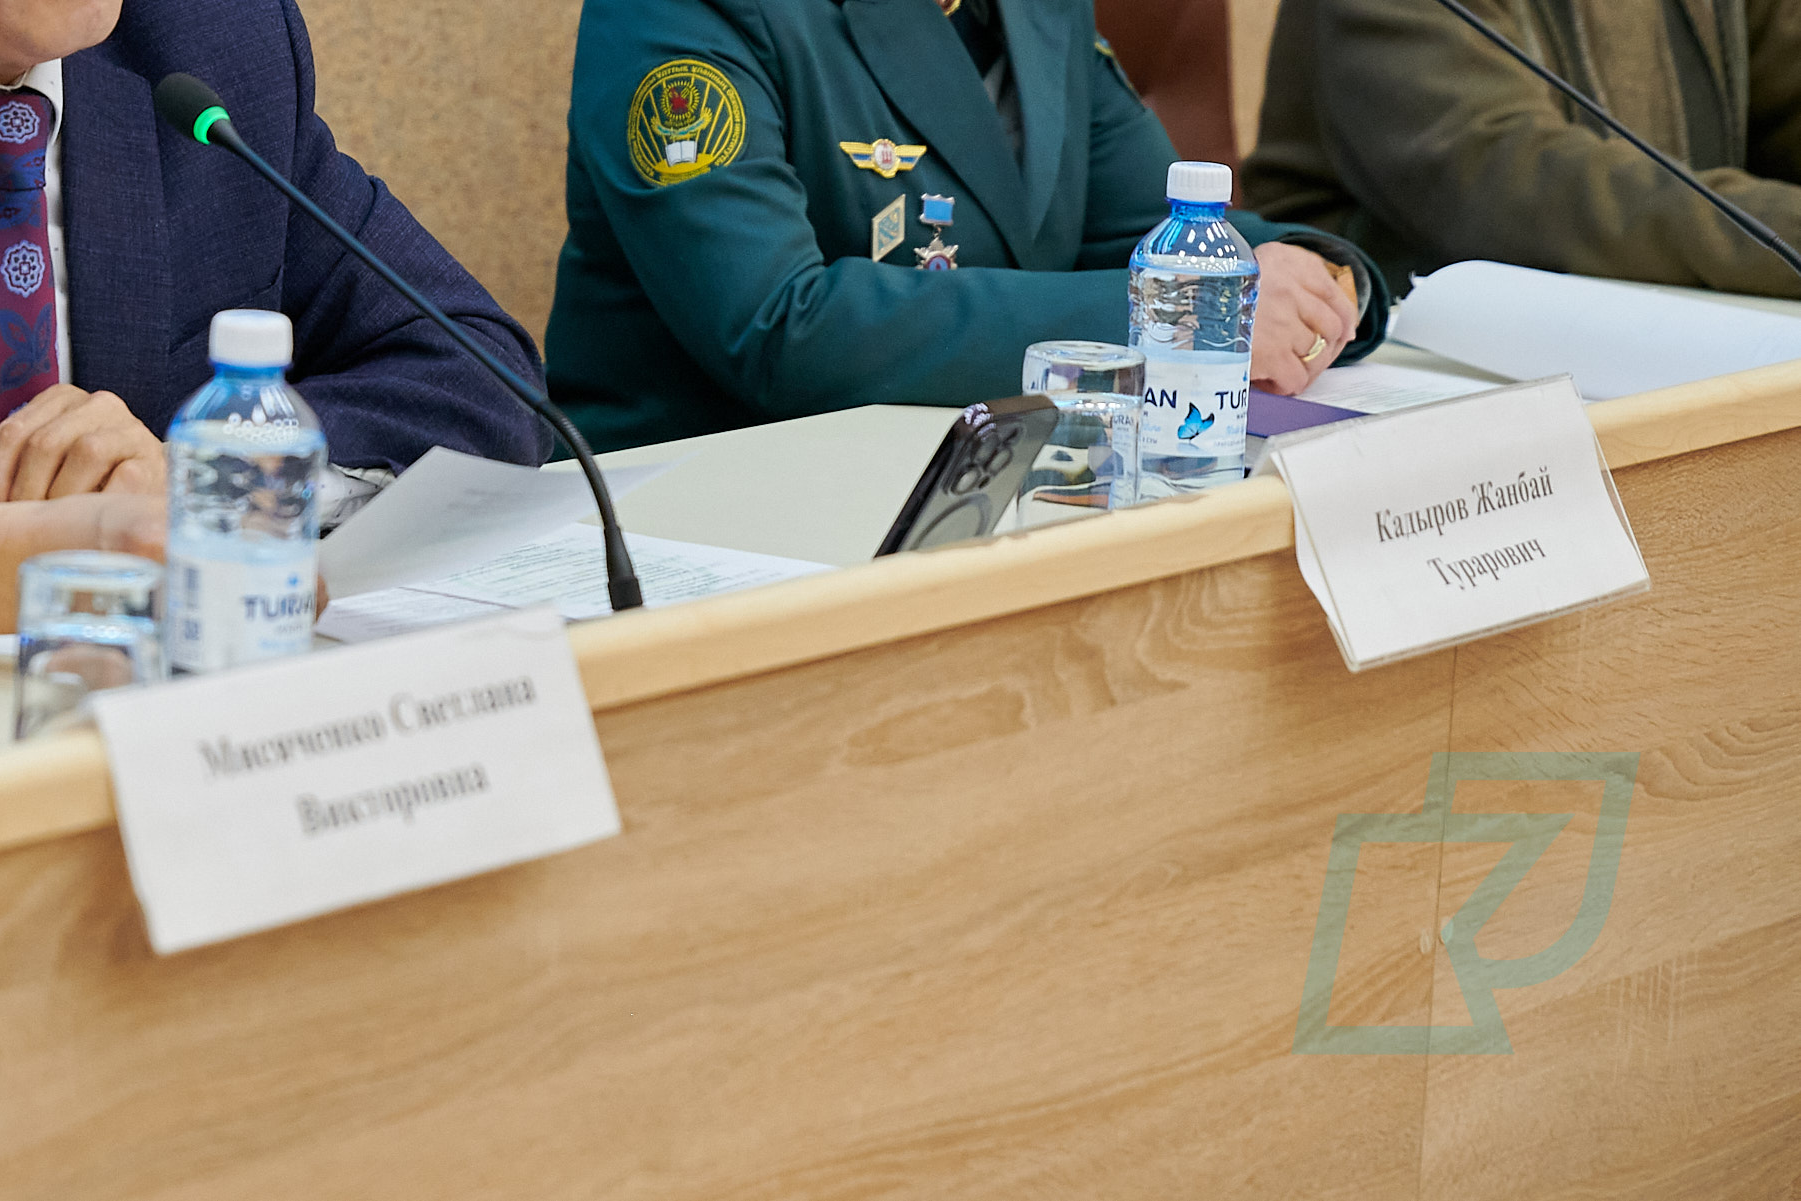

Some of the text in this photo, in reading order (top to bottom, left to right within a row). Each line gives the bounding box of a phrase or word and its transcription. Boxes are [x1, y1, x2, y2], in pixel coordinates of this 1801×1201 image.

[1374, 465, 1554, 543] Кадыров Жанбай
[1426, 538, 1547, 591] Турарович
[388, 676, 537, 736] Светлана
